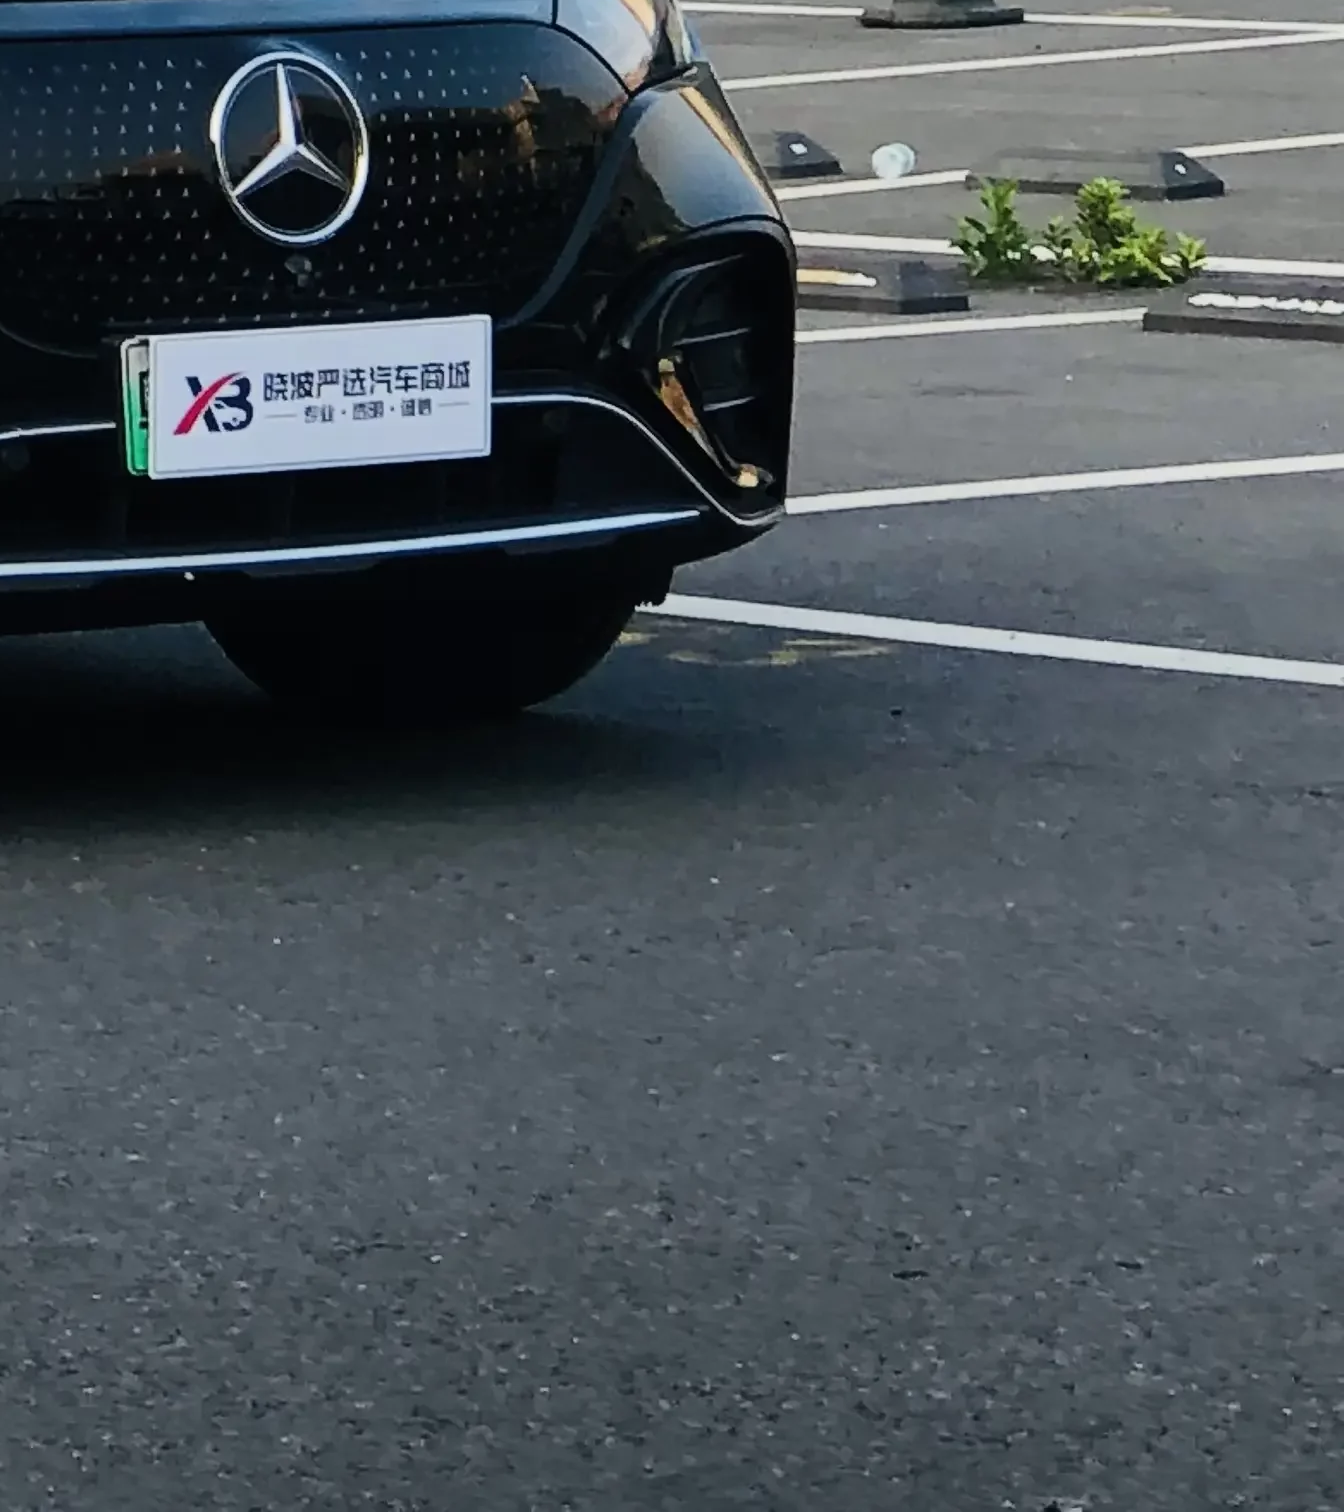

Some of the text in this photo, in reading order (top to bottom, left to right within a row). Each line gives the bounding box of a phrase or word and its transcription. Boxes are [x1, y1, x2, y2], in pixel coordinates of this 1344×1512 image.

[262, 360, 473, 402] 晓波严选汽车商城
